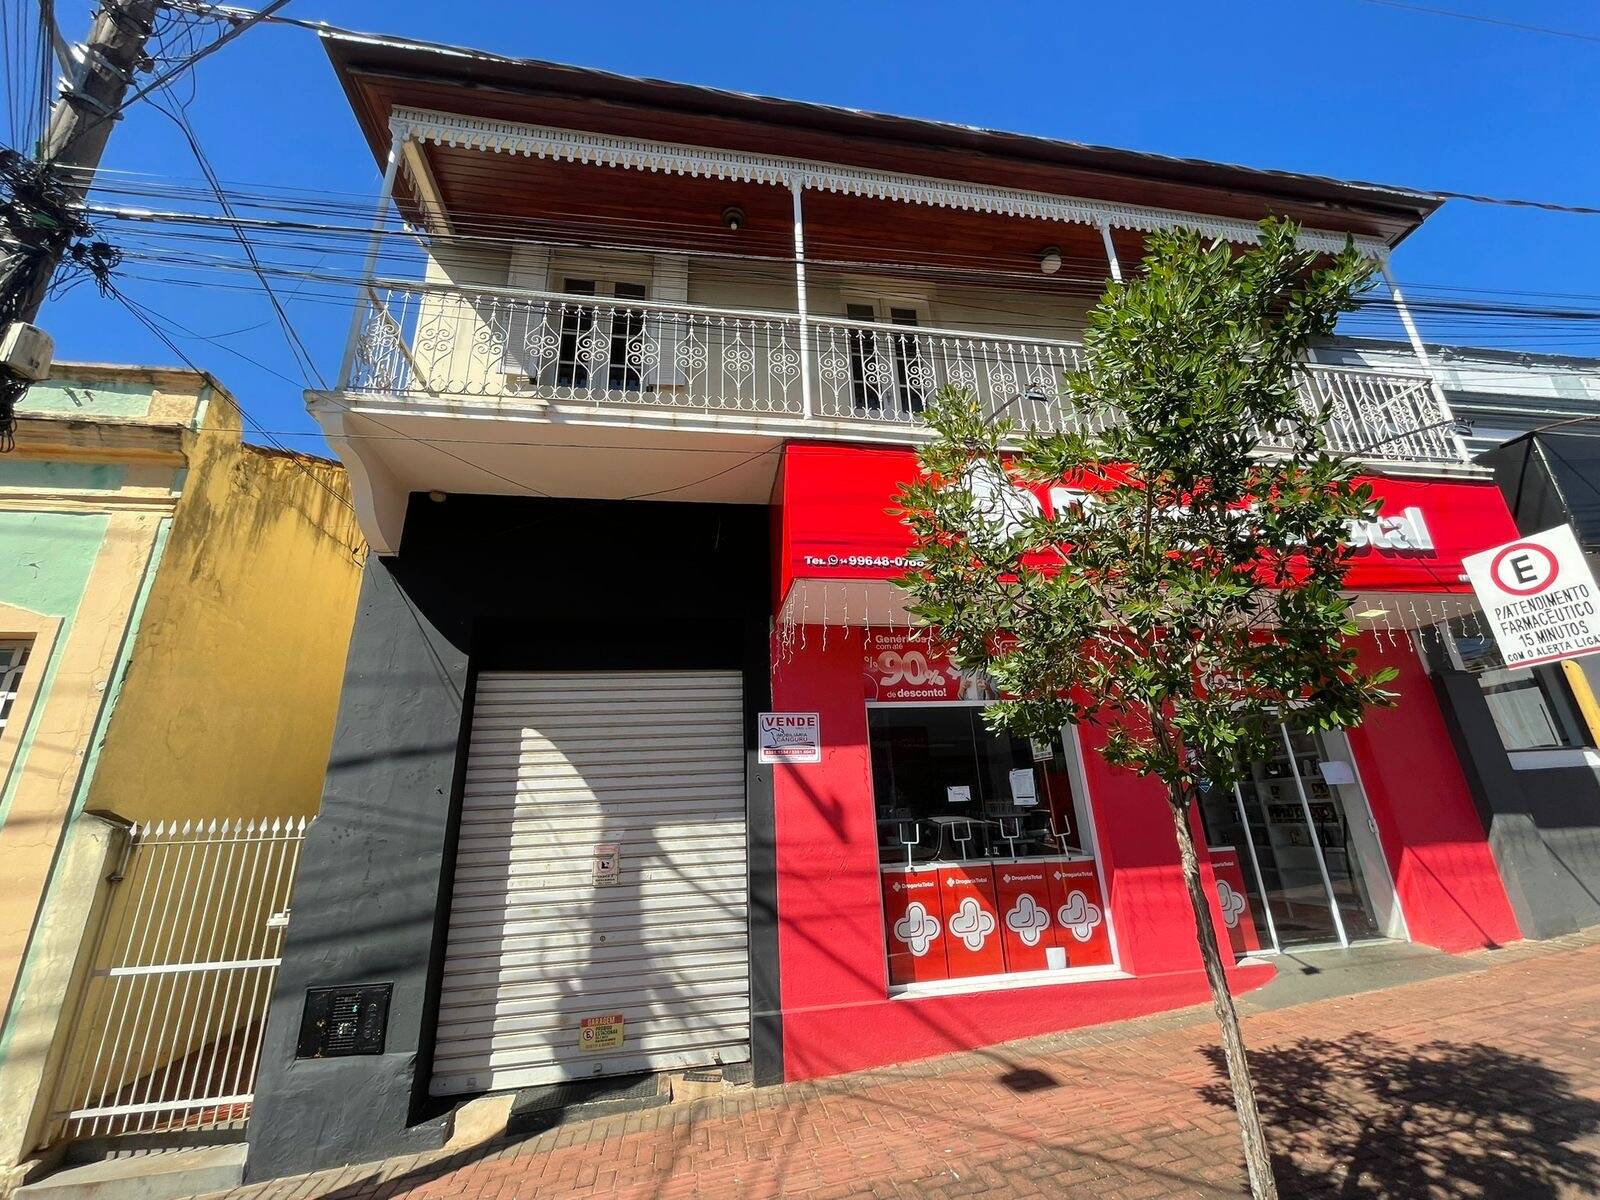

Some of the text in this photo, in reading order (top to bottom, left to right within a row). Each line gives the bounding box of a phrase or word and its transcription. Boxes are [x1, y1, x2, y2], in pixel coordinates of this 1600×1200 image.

[1510, 554, 1538, 585] E
[1494, 583, 1590, 621] P/ATENDIMENTO
[1500, 601, 1594, 636] FARMACÊUTICO
[1507, 634, 1600, 662] COM O ALERTA LIGA
[1519, 620, 1589, 647] 15 MINUTOS
[878, 651, 946, 686] 90%
[887, 688, 947, 698] de desconto!
[765, 717, 815, 726] VENDE
